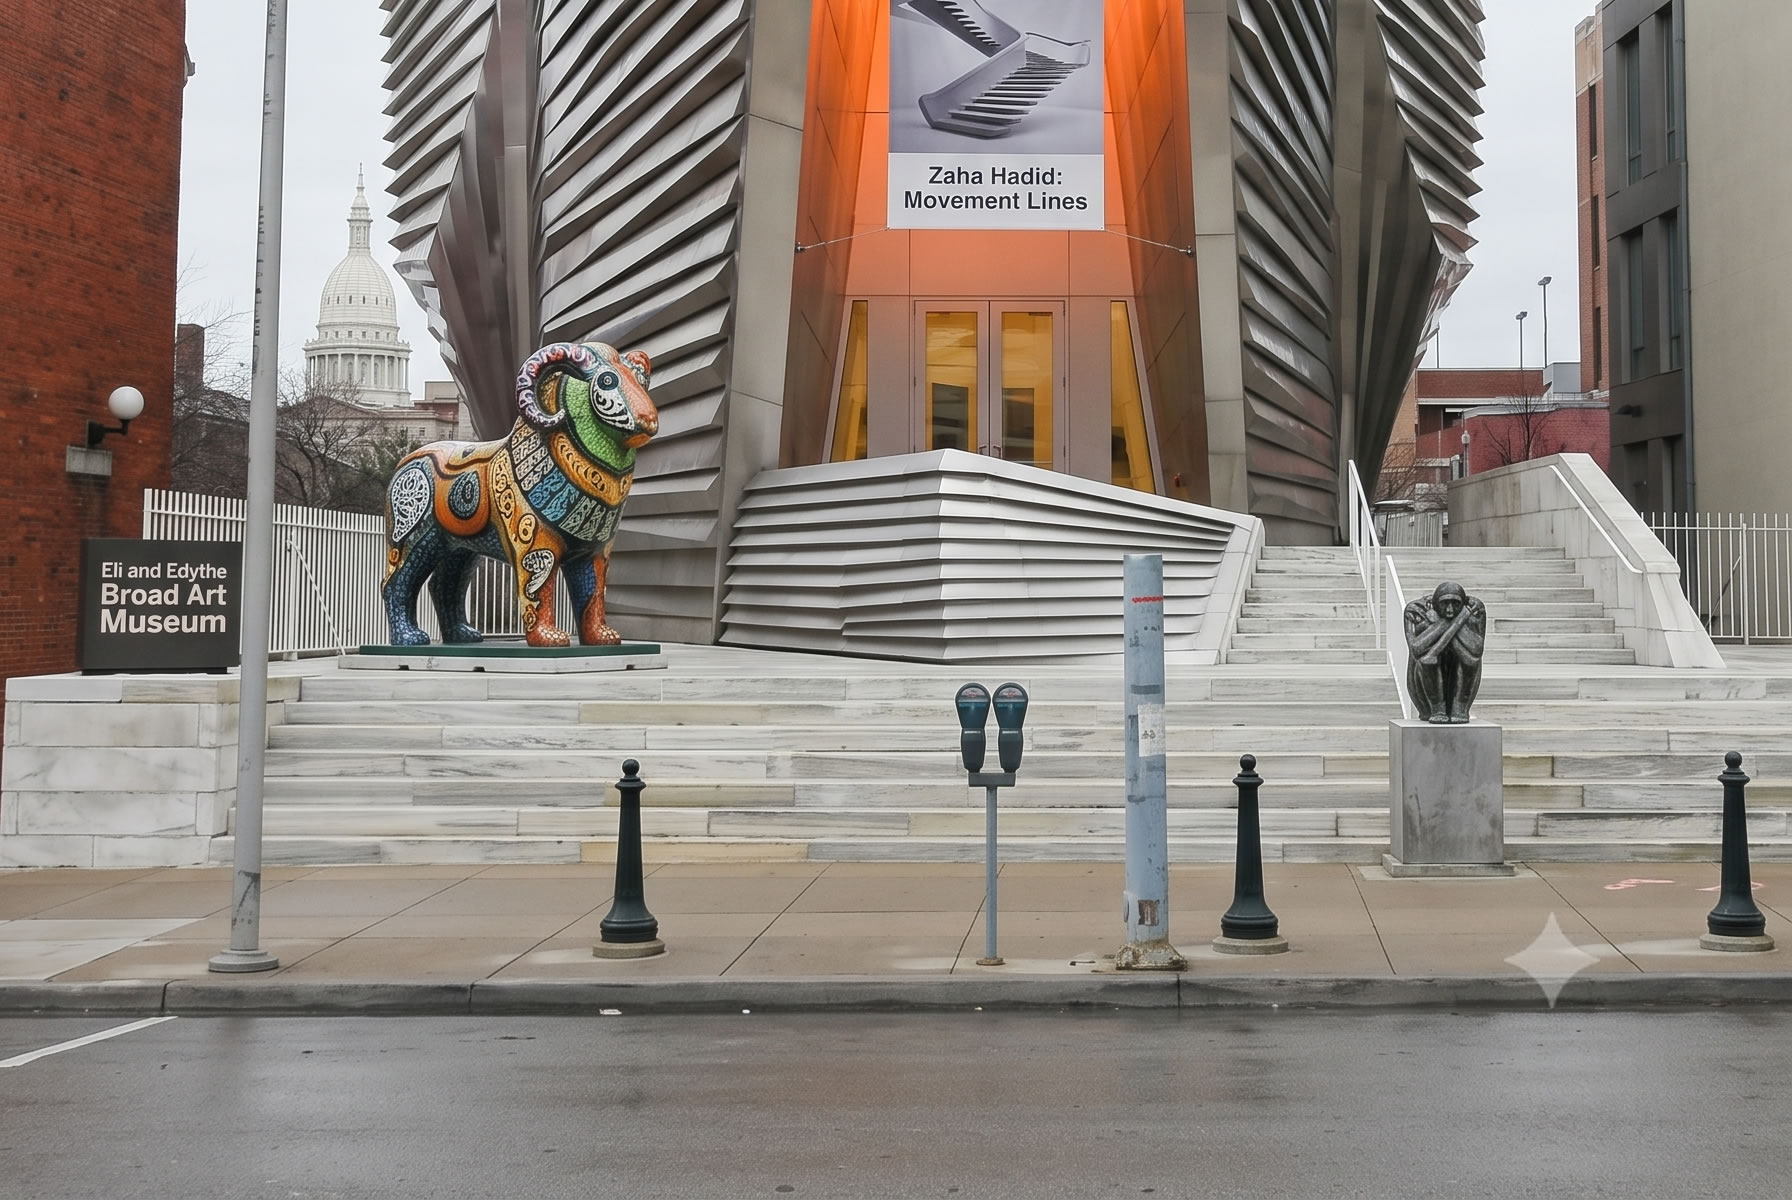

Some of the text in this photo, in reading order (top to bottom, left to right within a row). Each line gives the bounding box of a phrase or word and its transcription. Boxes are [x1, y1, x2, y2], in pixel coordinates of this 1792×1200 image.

[928, 166, 1063, 186] Zaha Hadid:
[904, 190, 1088, 211] Movement Lines
[101, 562, 227, 582] Eli and Edythe
[101, 582, 227, 606] Broad Art
[100, 608, 226, 634] Museum
